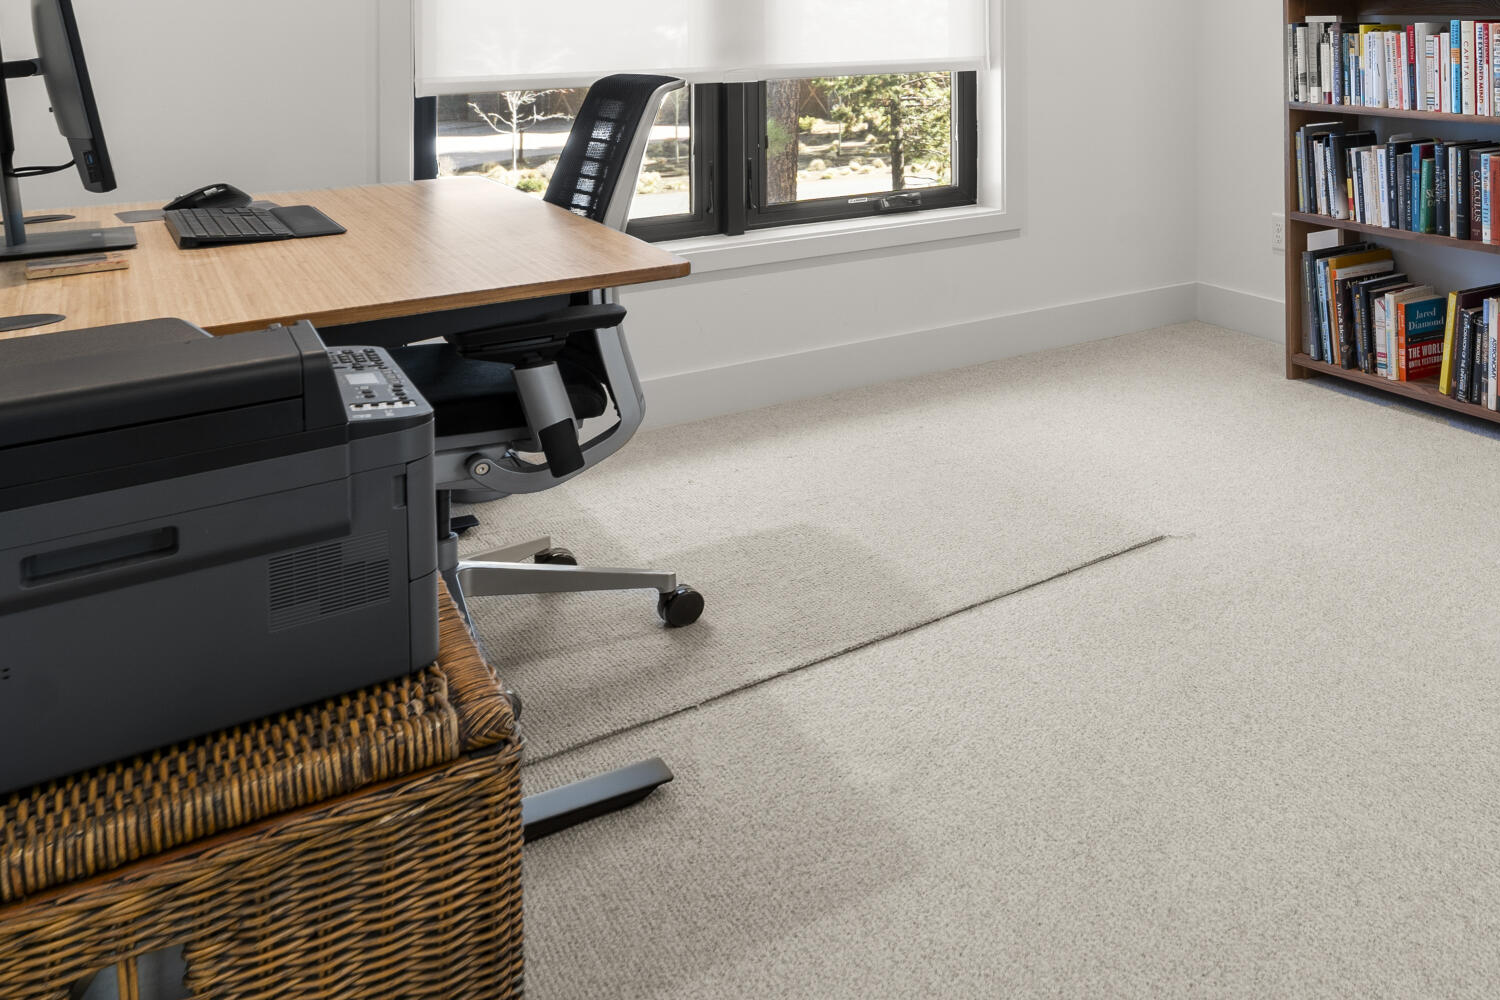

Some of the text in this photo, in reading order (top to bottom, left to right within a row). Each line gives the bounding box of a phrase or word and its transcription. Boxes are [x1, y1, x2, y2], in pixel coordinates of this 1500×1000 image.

[1416, 307, 1436, 321] Jared
[1408, 317, 1445, 331] Diamond
[1408, 346, 1421, 360] THE
